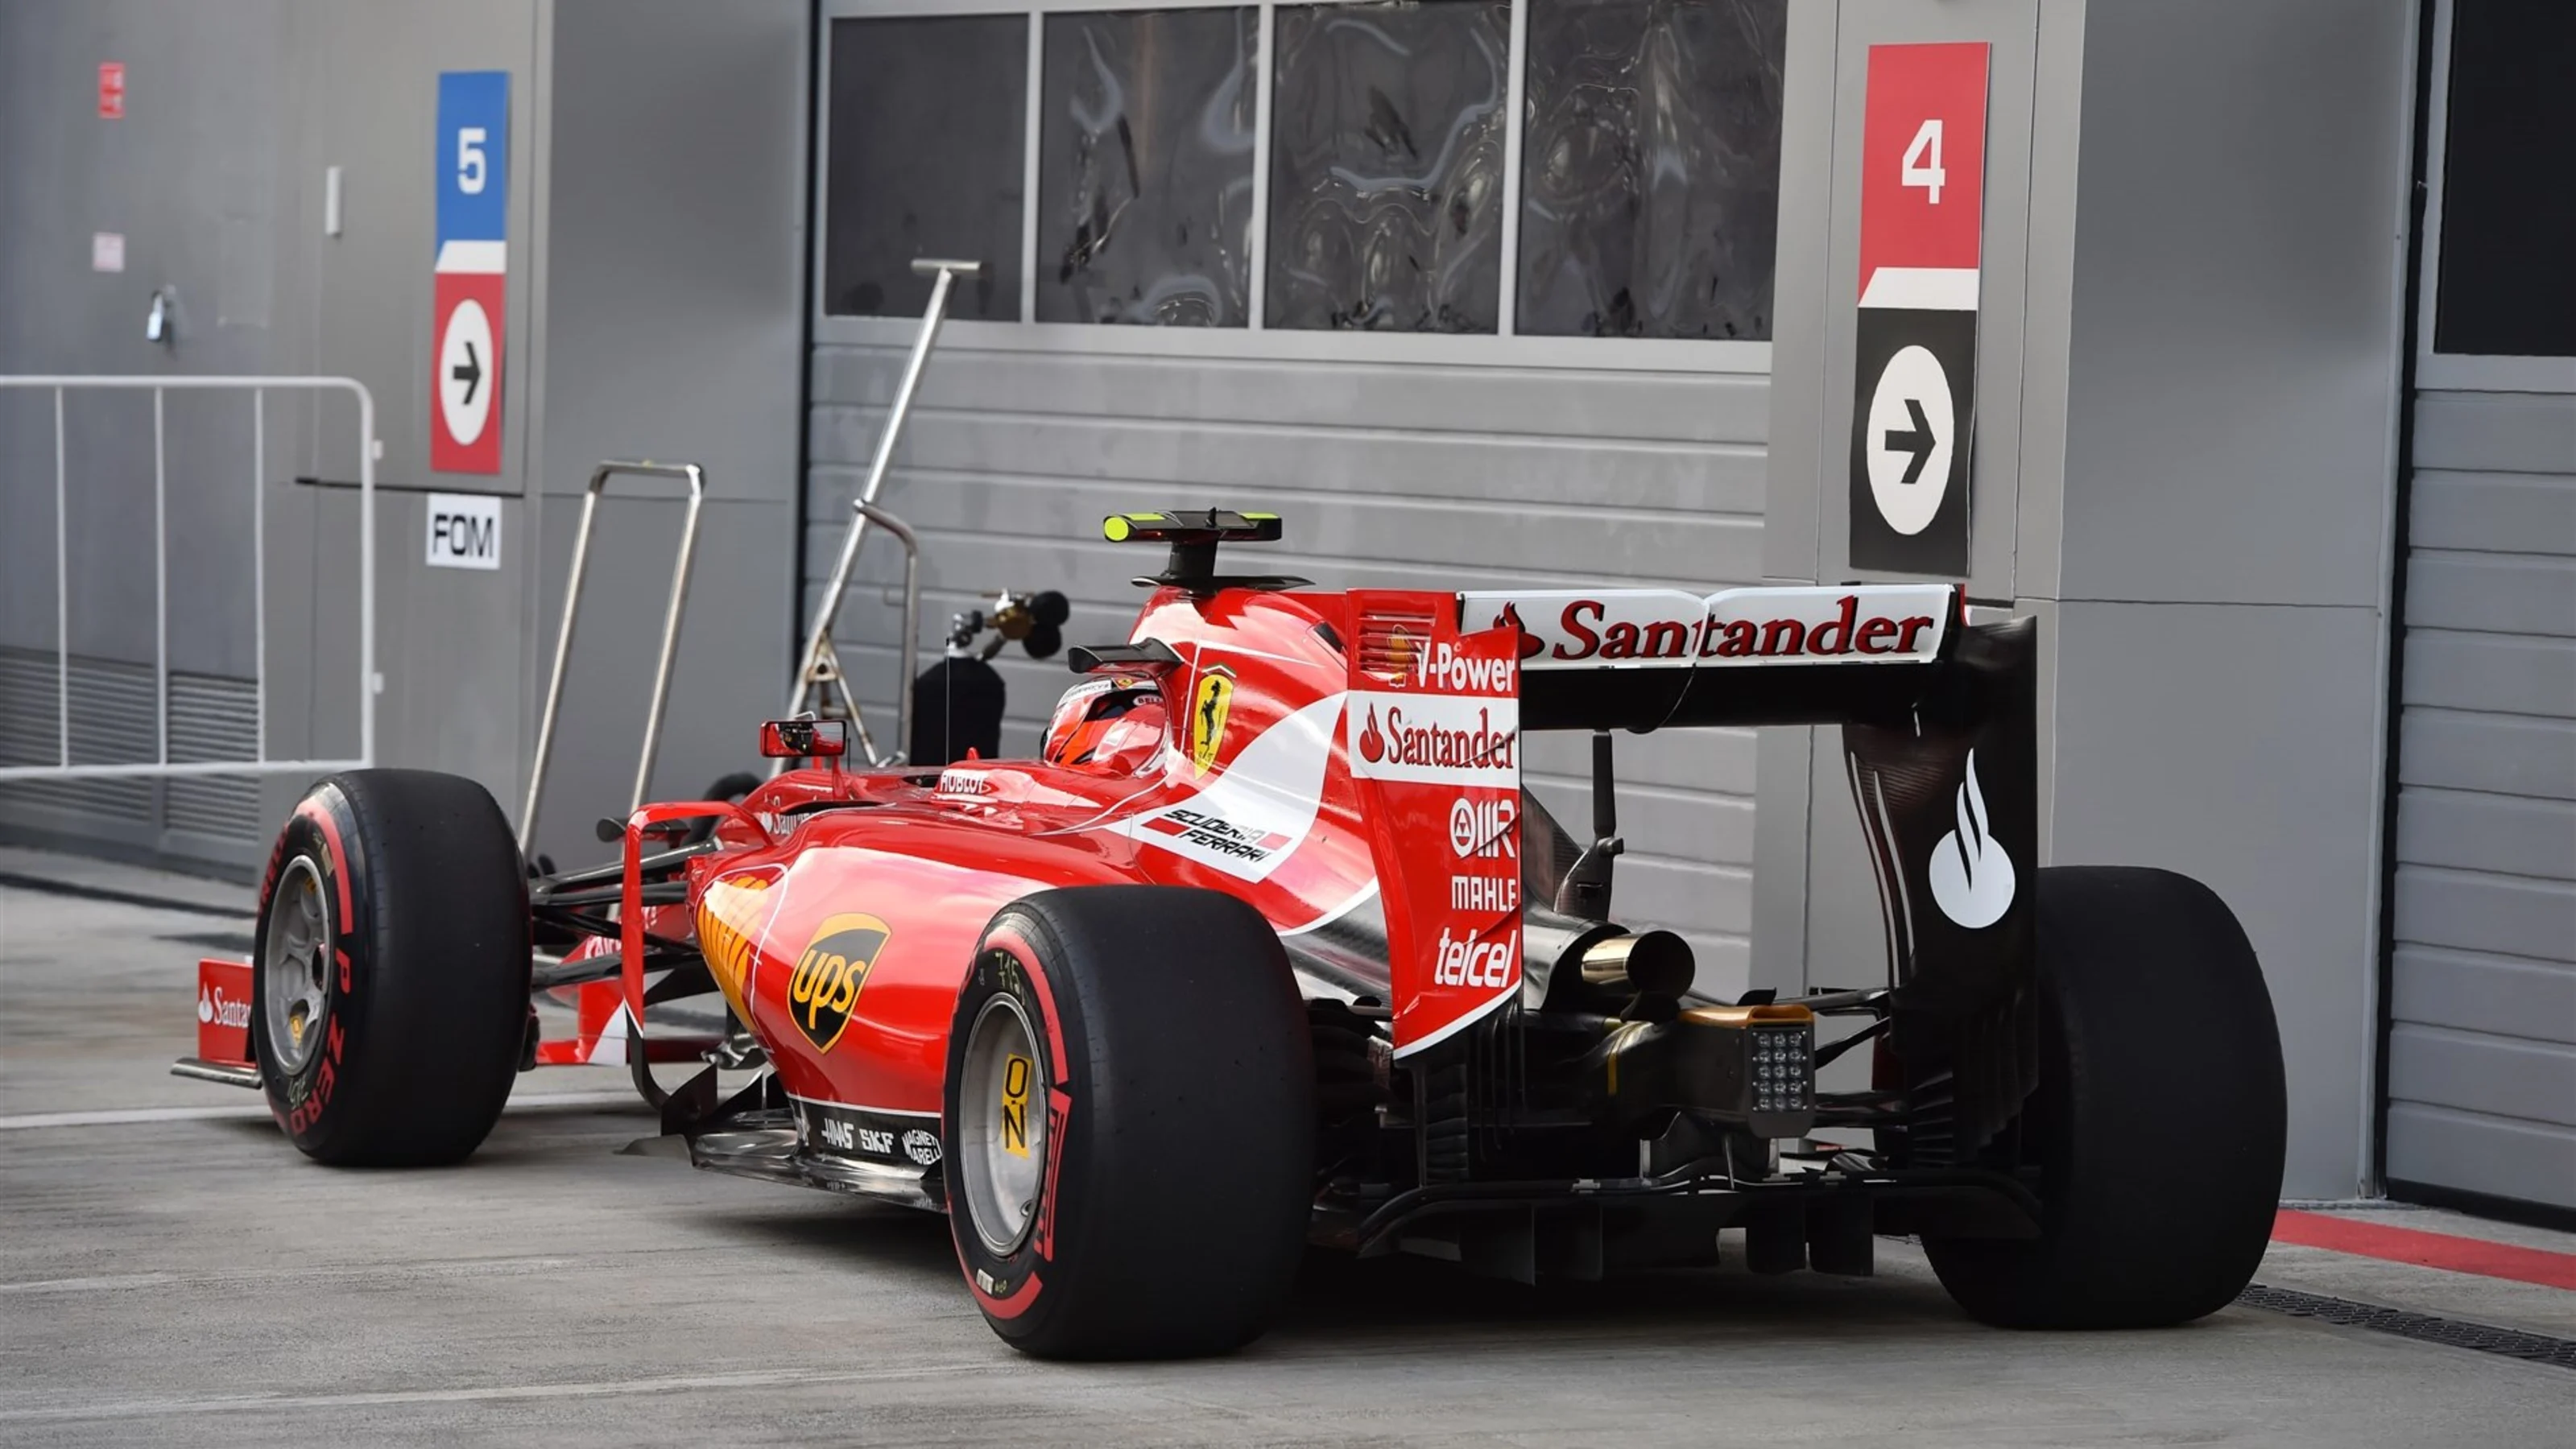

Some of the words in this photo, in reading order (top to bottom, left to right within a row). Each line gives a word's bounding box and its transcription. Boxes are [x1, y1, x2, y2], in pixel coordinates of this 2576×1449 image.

[457, 127, 486, 194] 5
[1902, 119, 1945, 204] 4
[432, 514, 493, 558] FOM
[1553, 594, 1933, 660] Santander
[1415, 642, 1515, 691] V-Power
[1387, 706, 1515, 770] Santander
[1163, 809, 1267, 844] SCUDERIA
[1178, 829, 1272, 863] FERRARI
[1452, 875, 1515, 912] MAHLE
[1434, 927, 1517, 988] telcel
[793, 950, 866, 1029] ups
[859, 1129, 894, 1154] SKF
